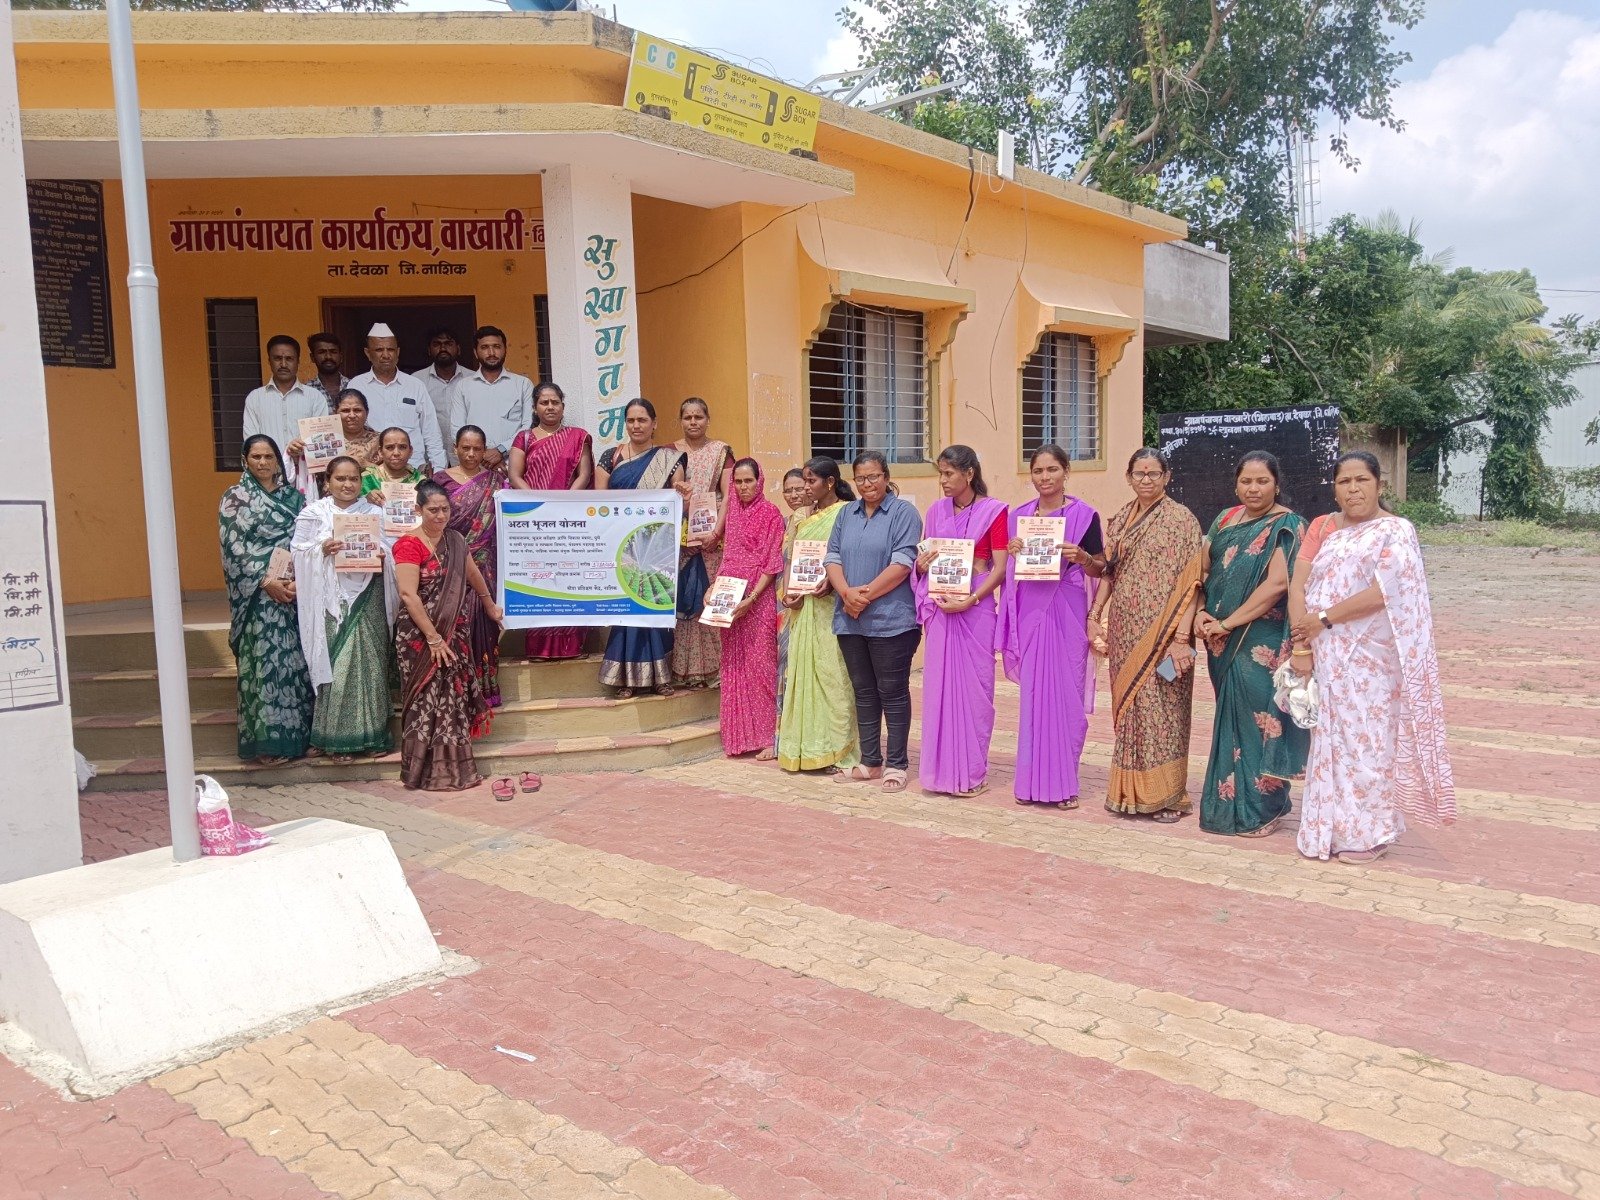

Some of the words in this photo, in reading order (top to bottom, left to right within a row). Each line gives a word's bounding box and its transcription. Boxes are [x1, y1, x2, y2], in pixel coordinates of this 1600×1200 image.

[730, 76, 746, 87] BOX
[731, 70, 757, 85] SUGAR
[795, 105, 816, 119] SUGAR
[793, 114, 806, 125] BOX
[169, 207, 313, 252] ग्रामपंचायत
[508, 520, 529, 528] अटल
[532, 520, 556, 531] भूजल
[559, 518, 587, 528] योजना
